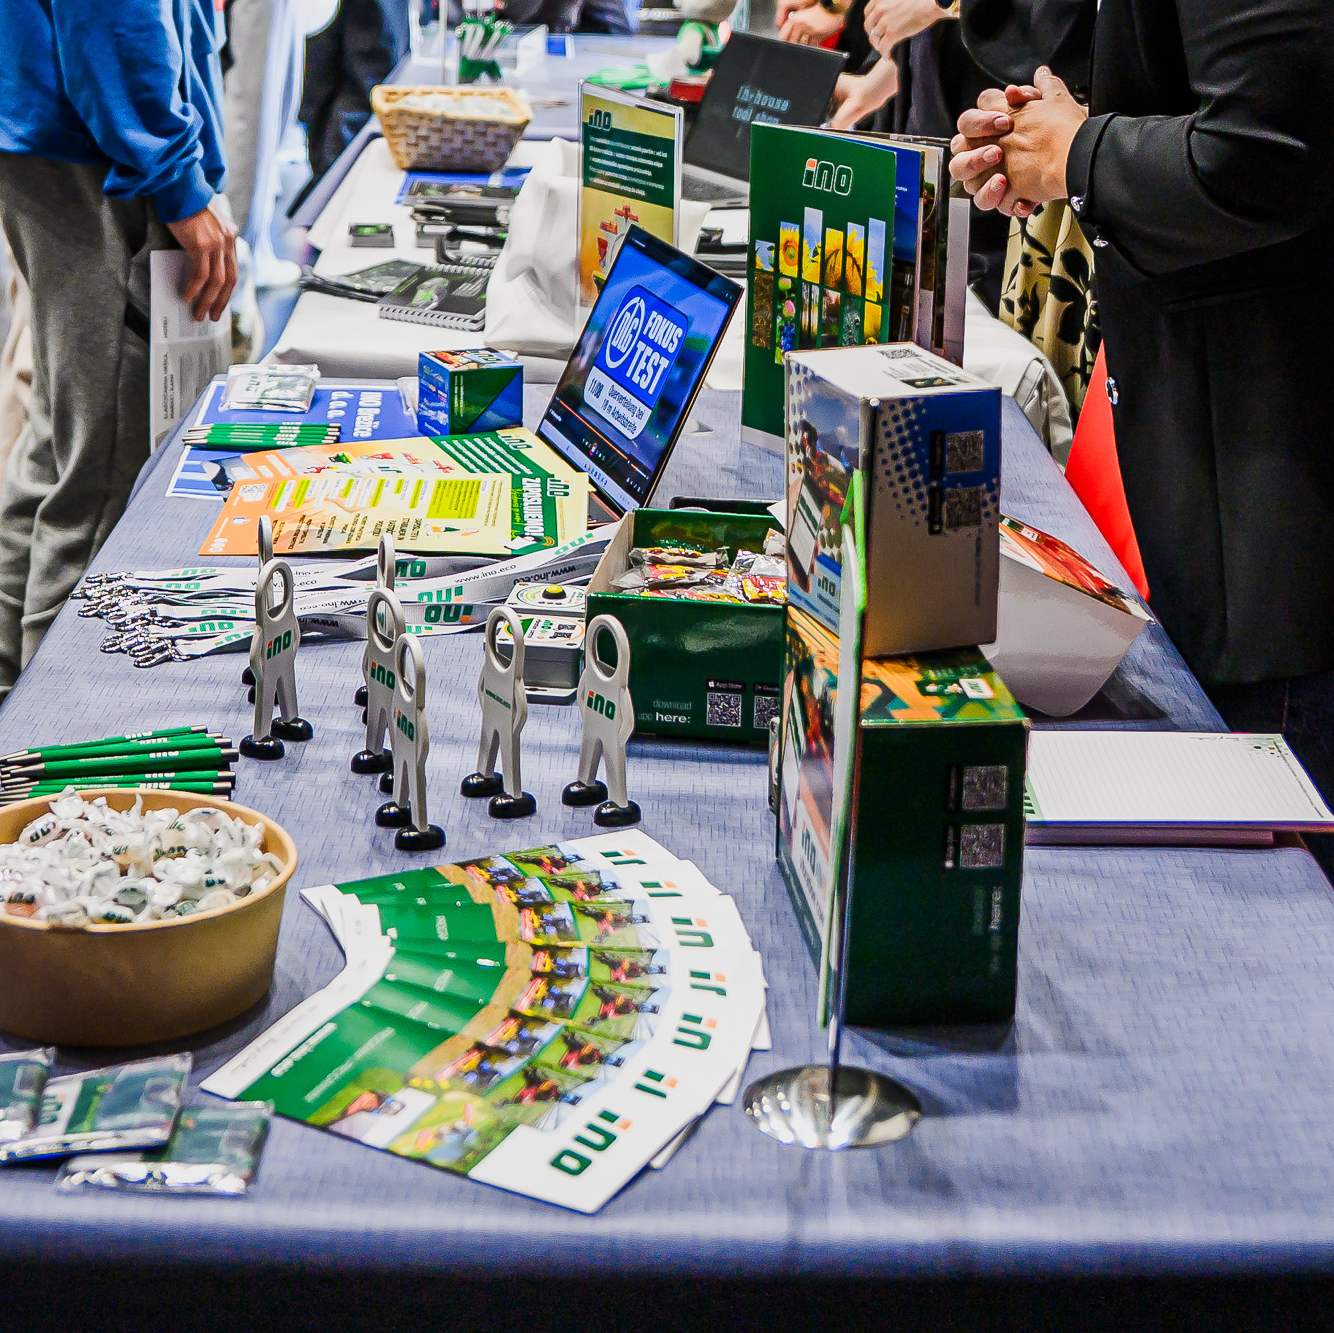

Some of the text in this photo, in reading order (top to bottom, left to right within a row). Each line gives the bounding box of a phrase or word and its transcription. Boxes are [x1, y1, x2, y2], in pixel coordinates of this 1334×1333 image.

[588, 107, 612, 132] ino
[802, 157, 854, 196] ino
[611, 306, 640, 353] DLG
[642, 310, 684, 354] FOKUS
[625, 340, 670, 395] TEST
[358, 391, 383, 407] INO
[547, 477, 570, 497] ino
[395, 559, 427, 579] no
[454, 564, 517, 585] www.ino.eco
[817, 573, 837, 597] ino
[267, 629, 292, 660] ino
[370, 661, 396, 690] ino
[587, 690, 616, 720] ino
[653, 698, 692, 711] download
[655, 711, 691, 724] here:
[396, 709, 415, 742] ino
[550, 1109, 632, 1177] ino
